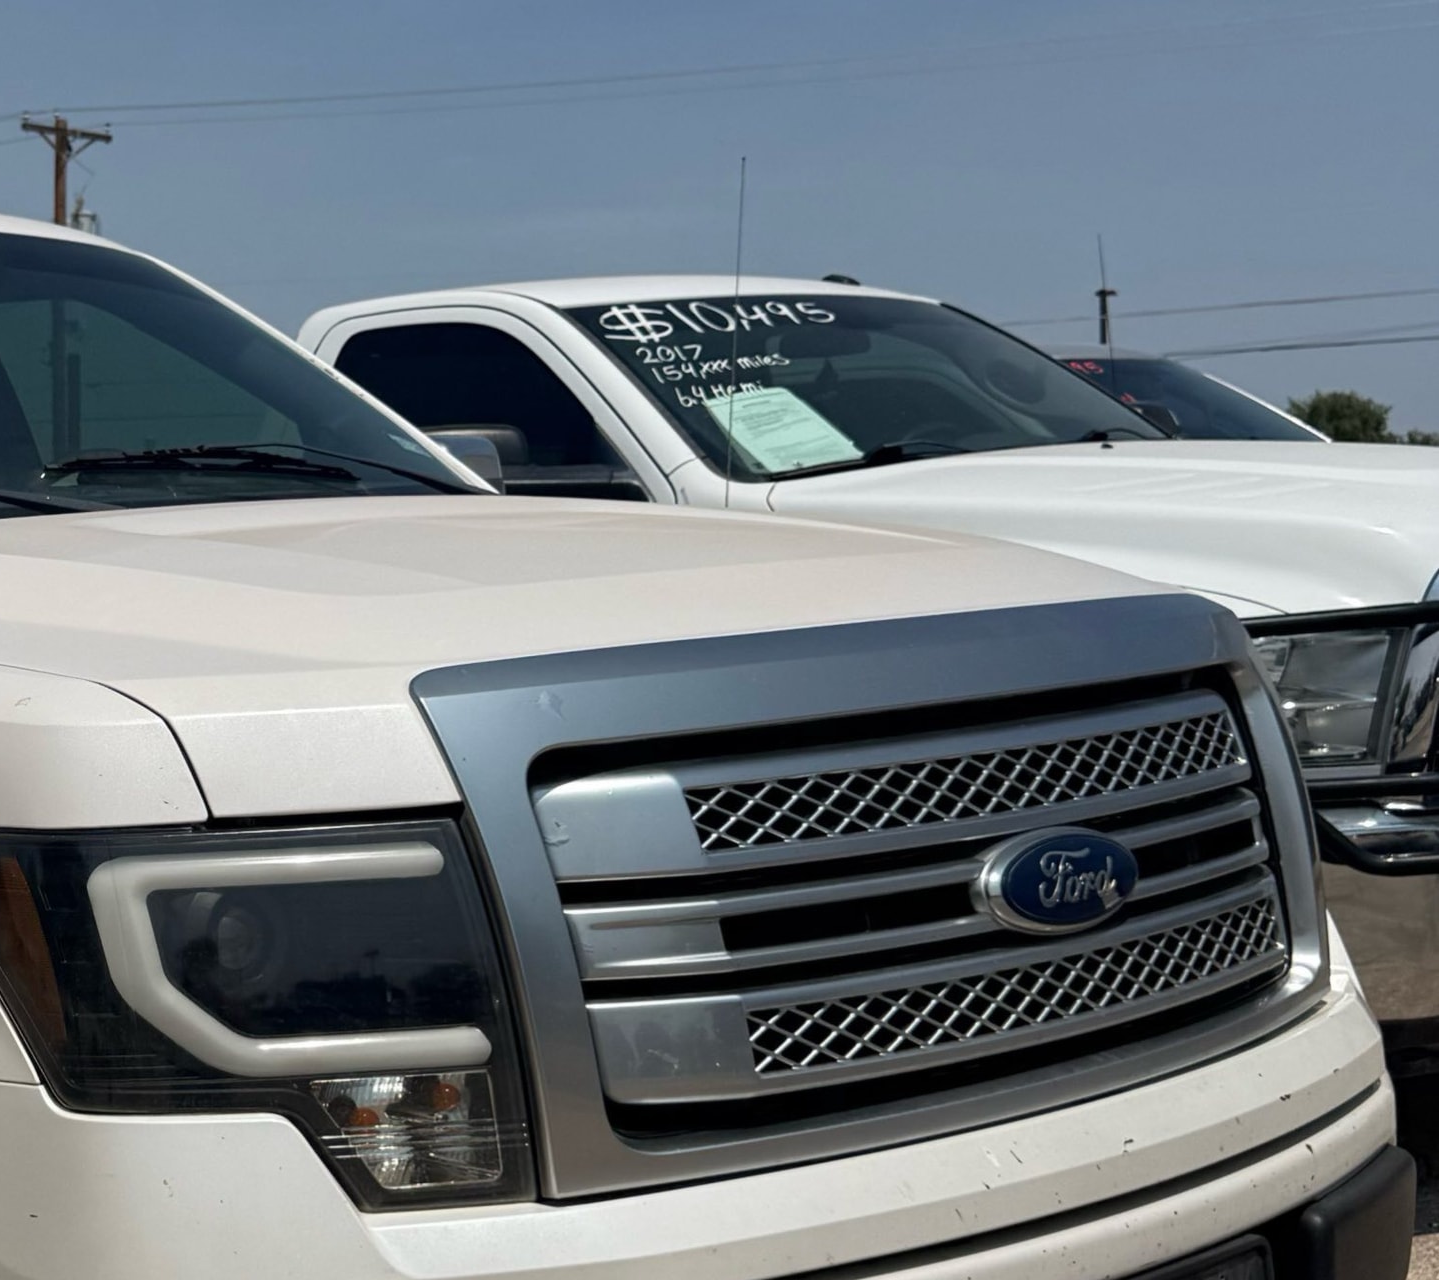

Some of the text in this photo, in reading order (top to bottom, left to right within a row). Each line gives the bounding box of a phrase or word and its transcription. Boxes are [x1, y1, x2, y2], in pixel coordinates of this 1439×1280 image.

[599, 301, 835, 343] $10,495
[636, 344, 702, 364] 2017
[736, 353, 790, 370] miles
[1038, 846, 1118, 909] Ford
